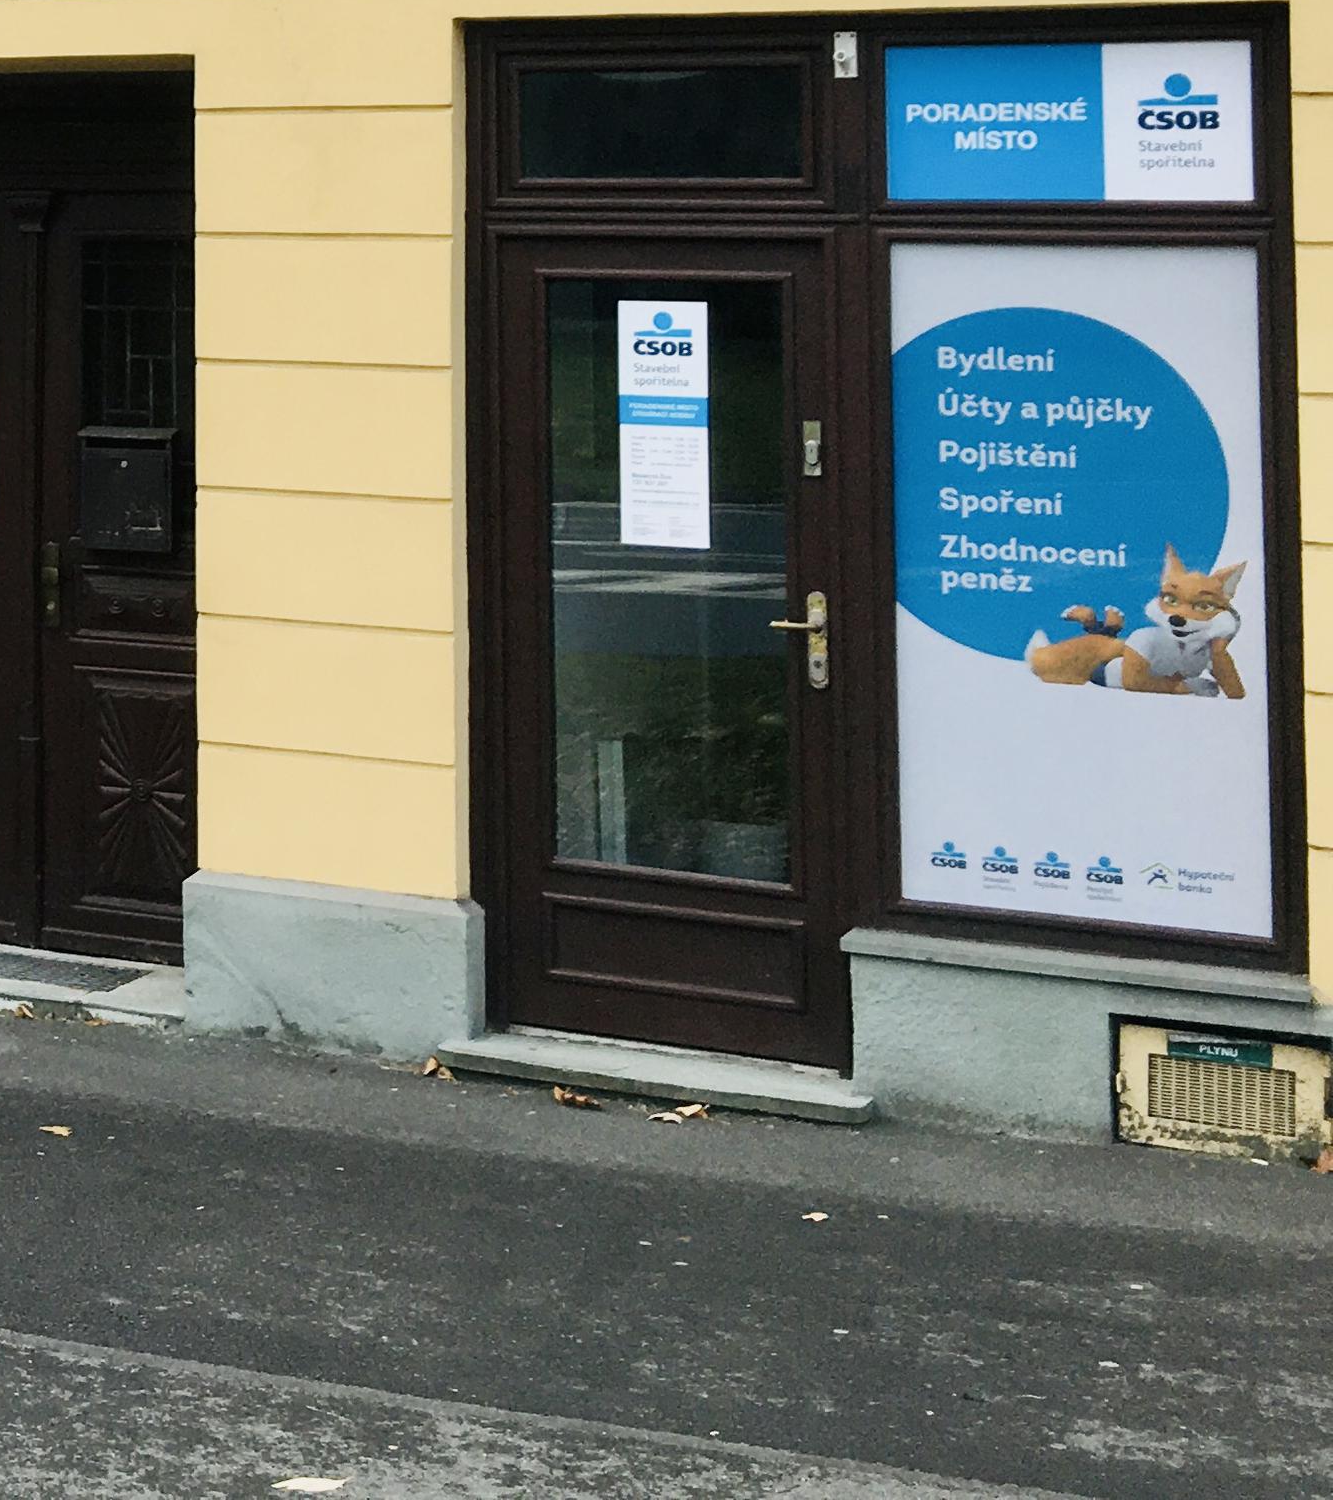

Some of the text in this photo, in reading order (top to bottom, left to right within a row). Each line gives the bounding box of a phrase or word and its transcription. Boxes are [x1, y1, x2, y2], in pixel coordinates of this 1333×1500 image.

[906, 97, 1088, 123] PORADENSKÉ
[1137, 108, 1220, 130] ČSOB
[954, 126, 1038, 151] MÍSTO
[1138, 139, 1202, 153] Stavební
[1139, 155, 1215, 172] spořitelna
[633, 338, 693, 357] ČSOB
[633, 362, 680, 374] Stavební
[936, 346, 1055, 376] Bydlení
[633, 376, 690, 389] spořitelna
[937, 387, 1152, 430] Účty a půjčky
[938, 440, 1077, 472] Pojištění
[938, 486, 1063, 518] Spoření
[939, 534, 1126, 568] Zhodnocení
[941, 569, 1033, 595] peněz
[1178, 882, 1213, 894] banka
[1199, 1044, 1239, 1058] PLYNU
